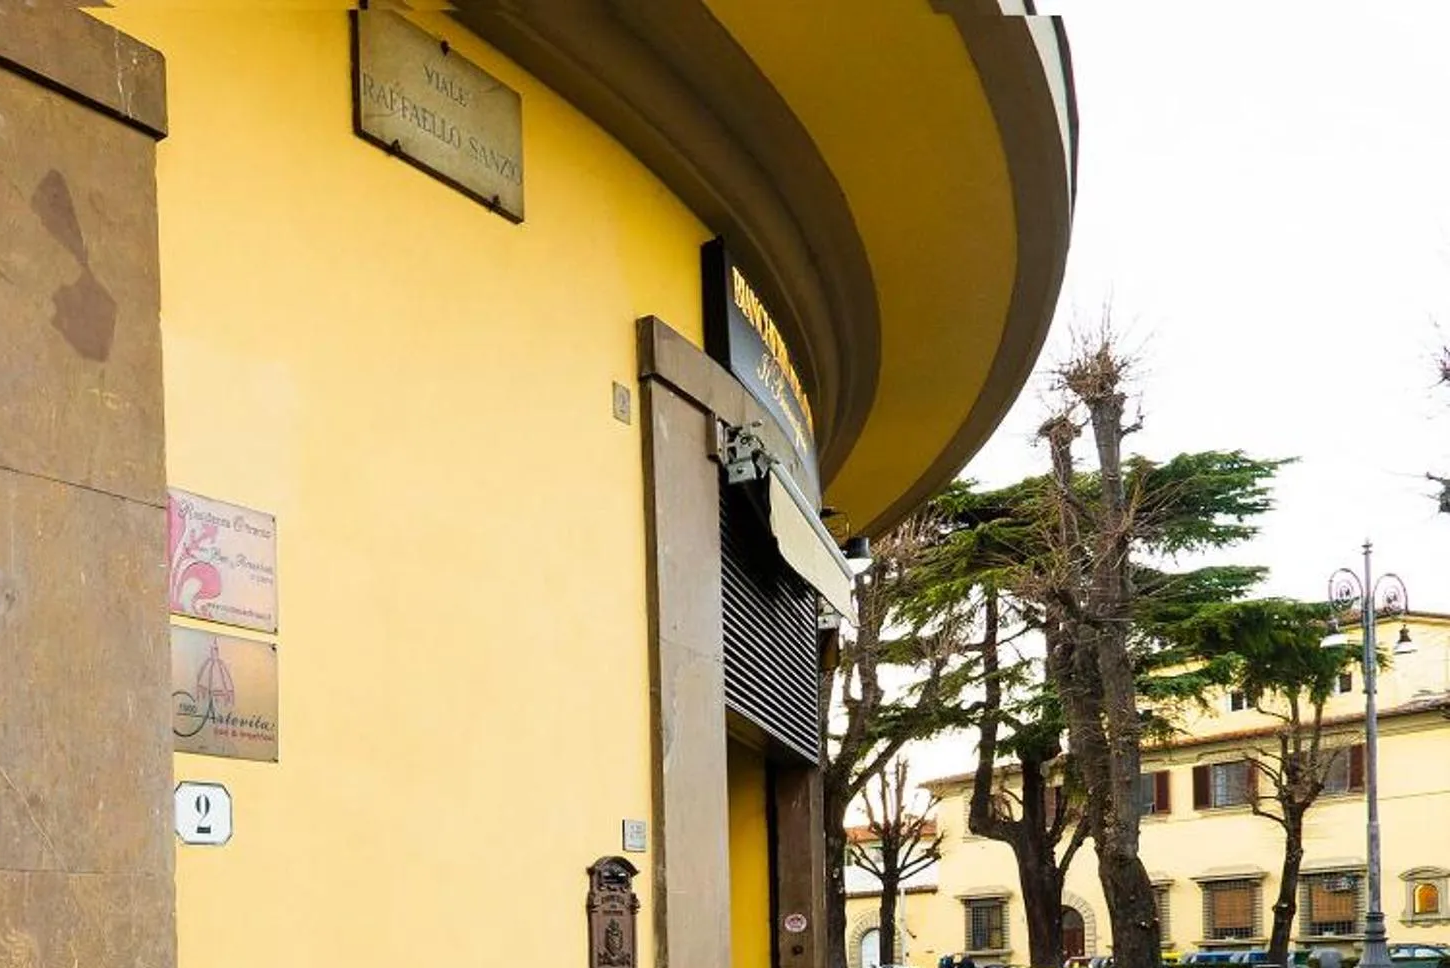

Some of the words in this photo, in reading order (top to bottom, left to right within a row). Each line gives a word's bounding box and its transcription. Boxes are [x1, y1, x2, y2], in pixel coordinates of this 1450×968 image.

[422, 63, 469, 108] VIALE
[363, 72, 461, 148] RAFFAELLO
[195, 793, 212, 834] 2
